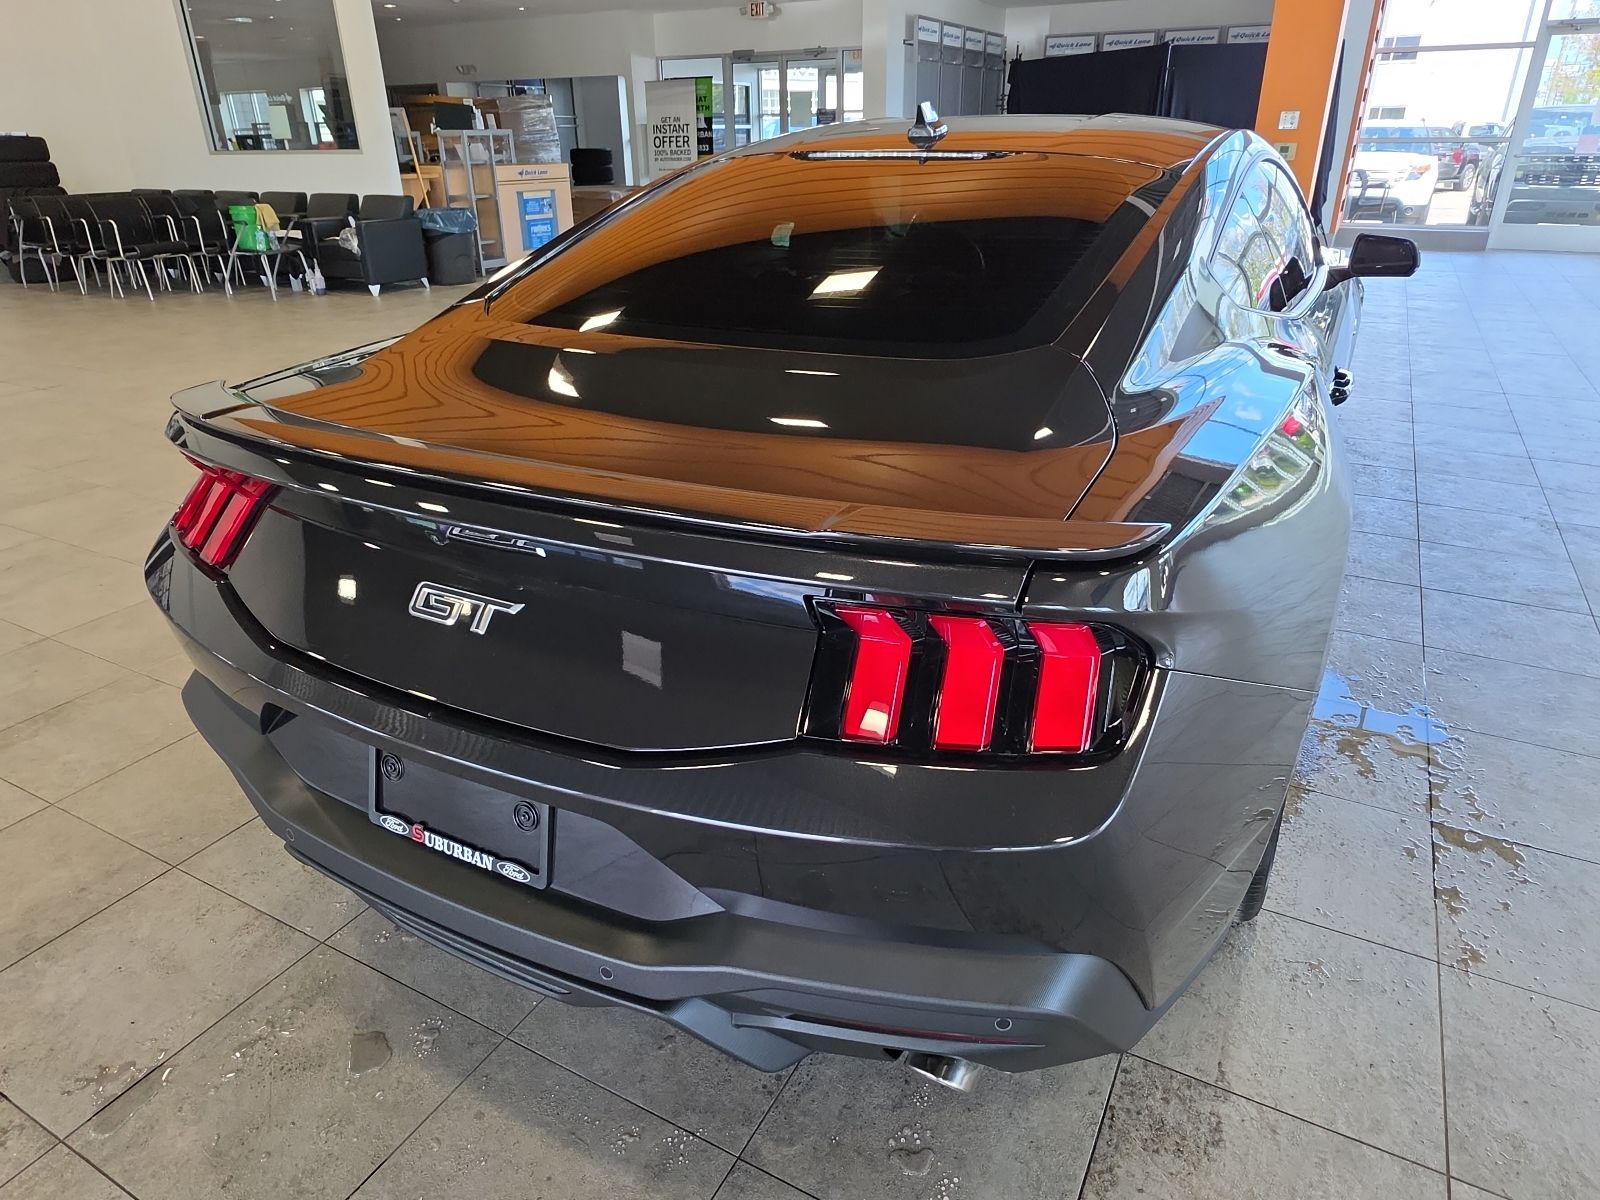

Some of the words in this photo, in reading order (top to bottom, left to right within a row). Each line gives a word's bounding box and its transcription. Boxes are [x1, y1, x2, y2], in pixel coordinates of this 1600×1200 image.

[750, 2, 765, 17] EXIT
[652, 124, 690, 135] INSTANT
[653, 136, 690, 149] OFFER
[654, 149, 669, 157] 100%
[669, 149, 692, 157] BACKED
[408, 581, 525, 635] GT
[384, 816, 405, 834] Ford
[411, 823, 494, 871] SUBURBAN
[502, 862, 525, 881] Ford
